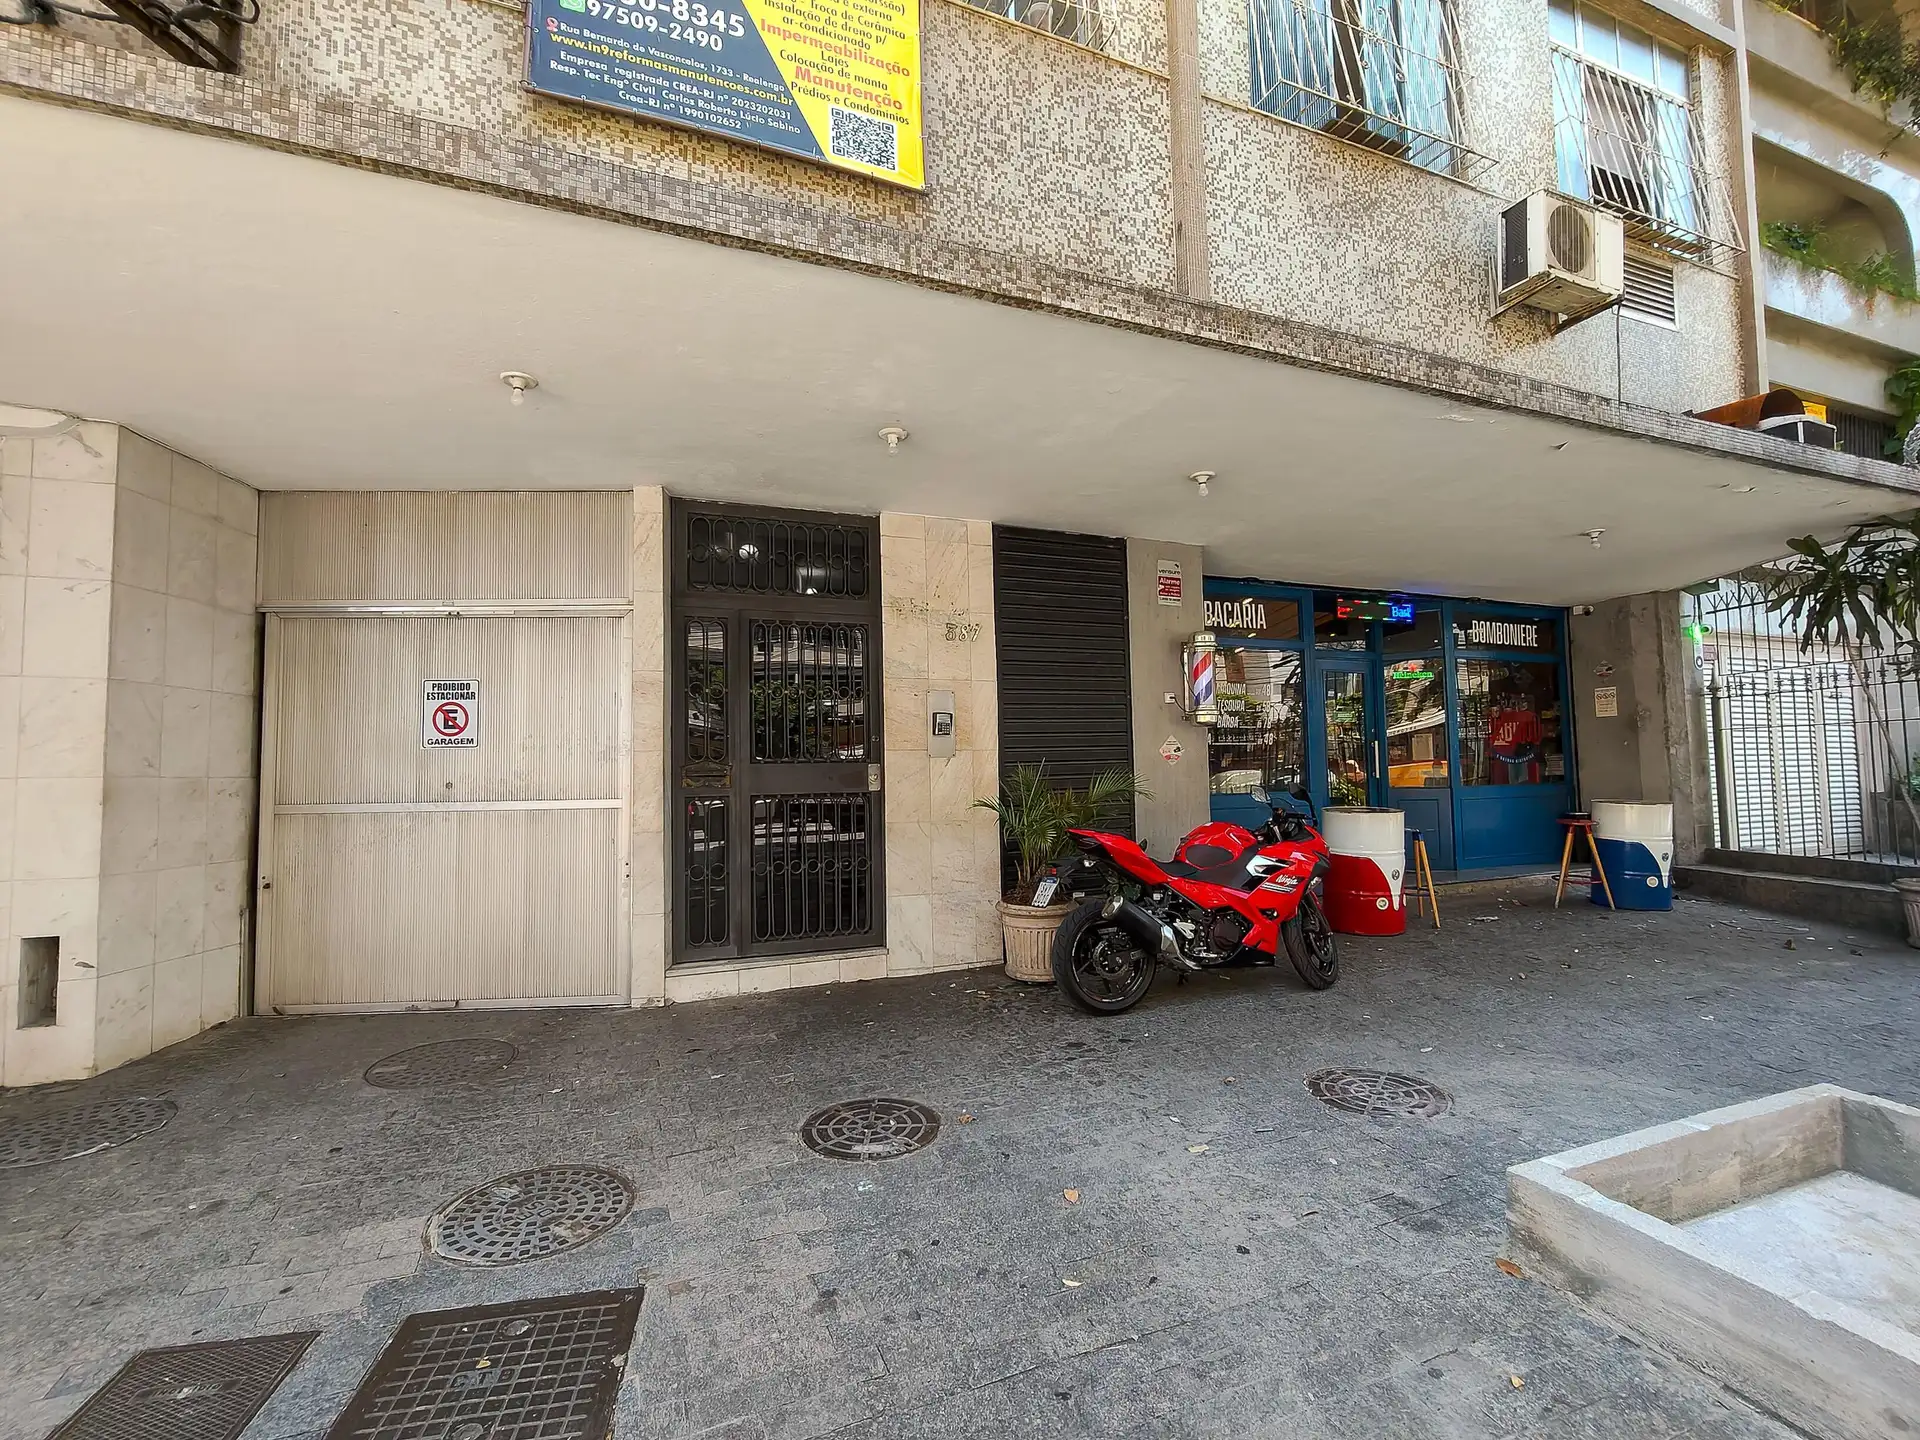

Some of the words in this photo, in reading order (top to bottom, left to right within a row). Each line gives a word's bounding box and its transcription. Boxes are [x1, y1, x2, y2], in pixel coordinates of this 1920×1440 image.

[587, 0, 723, 51] 97509-2490
[764, 0, 821, 22] Instalação
[825, 16, 838, 28] de
[841, 21, 872, 40] dreno
[876, 35, 887, 46] p/
[841, 10, 854, 21] de
[858, 15, 906, 39] Cerâmica
[853, 2, 892, 21] externa
[761, 18, 910, 77] Impermeabilização
[782, 16, 871, 50] ar-condicionado
[550, 33, 794, 106] www.in9reformasmanutencoes.com.br
[560, 22, 580, 36] Rua
[583, 29, 630, 49] Bernardo
[633, 42, 646, 53] de
[648, 46, 708, 71] Vasconcelos,
[711, 63, 733, 78] 1733
[742, 72, 785, 92] Realengo
[780, 49, 834, 74] Colocação
[837, 67, 851, 79] de
[854, 74, 888, 91] manta
[821, 51, 849, 69] Lajes
[550, 60, 580, 76] Resp.
[583, 69, 601, 81] Tec
[632, 82, 656, 96] Civil
[661, 90, 695, 106] Carlos
[698, 98, 737, 117] Roberto
[740, 110, 765, 125] Lúcio
[767, 117, 801, 134] Sabino
[560, 50, 608, 71] Empresa
[614, 67, 670, 88] registrada
[673, 81, 715, 99] CREA-RJ
[731, 97, 791, 120] 2023202031
[791, 81, 831, 101] Prédios
[795, 65, 903, 110] Manutenção
[619, 91, 660, 108] Crea-RJ
[679, 105, 741, 129] 1990102652
[1204, 600, 1267, 630] BACARIA
[1472, 620, 1538, 647] BOMBONIERE
[426, 691, 476, 701] ESTACIONAR
[432, 682, 471, 691] PROIBIDO
[427, 737, 474, 746] GARAGEM
[1276, 875, 1298, 886] Ninja
